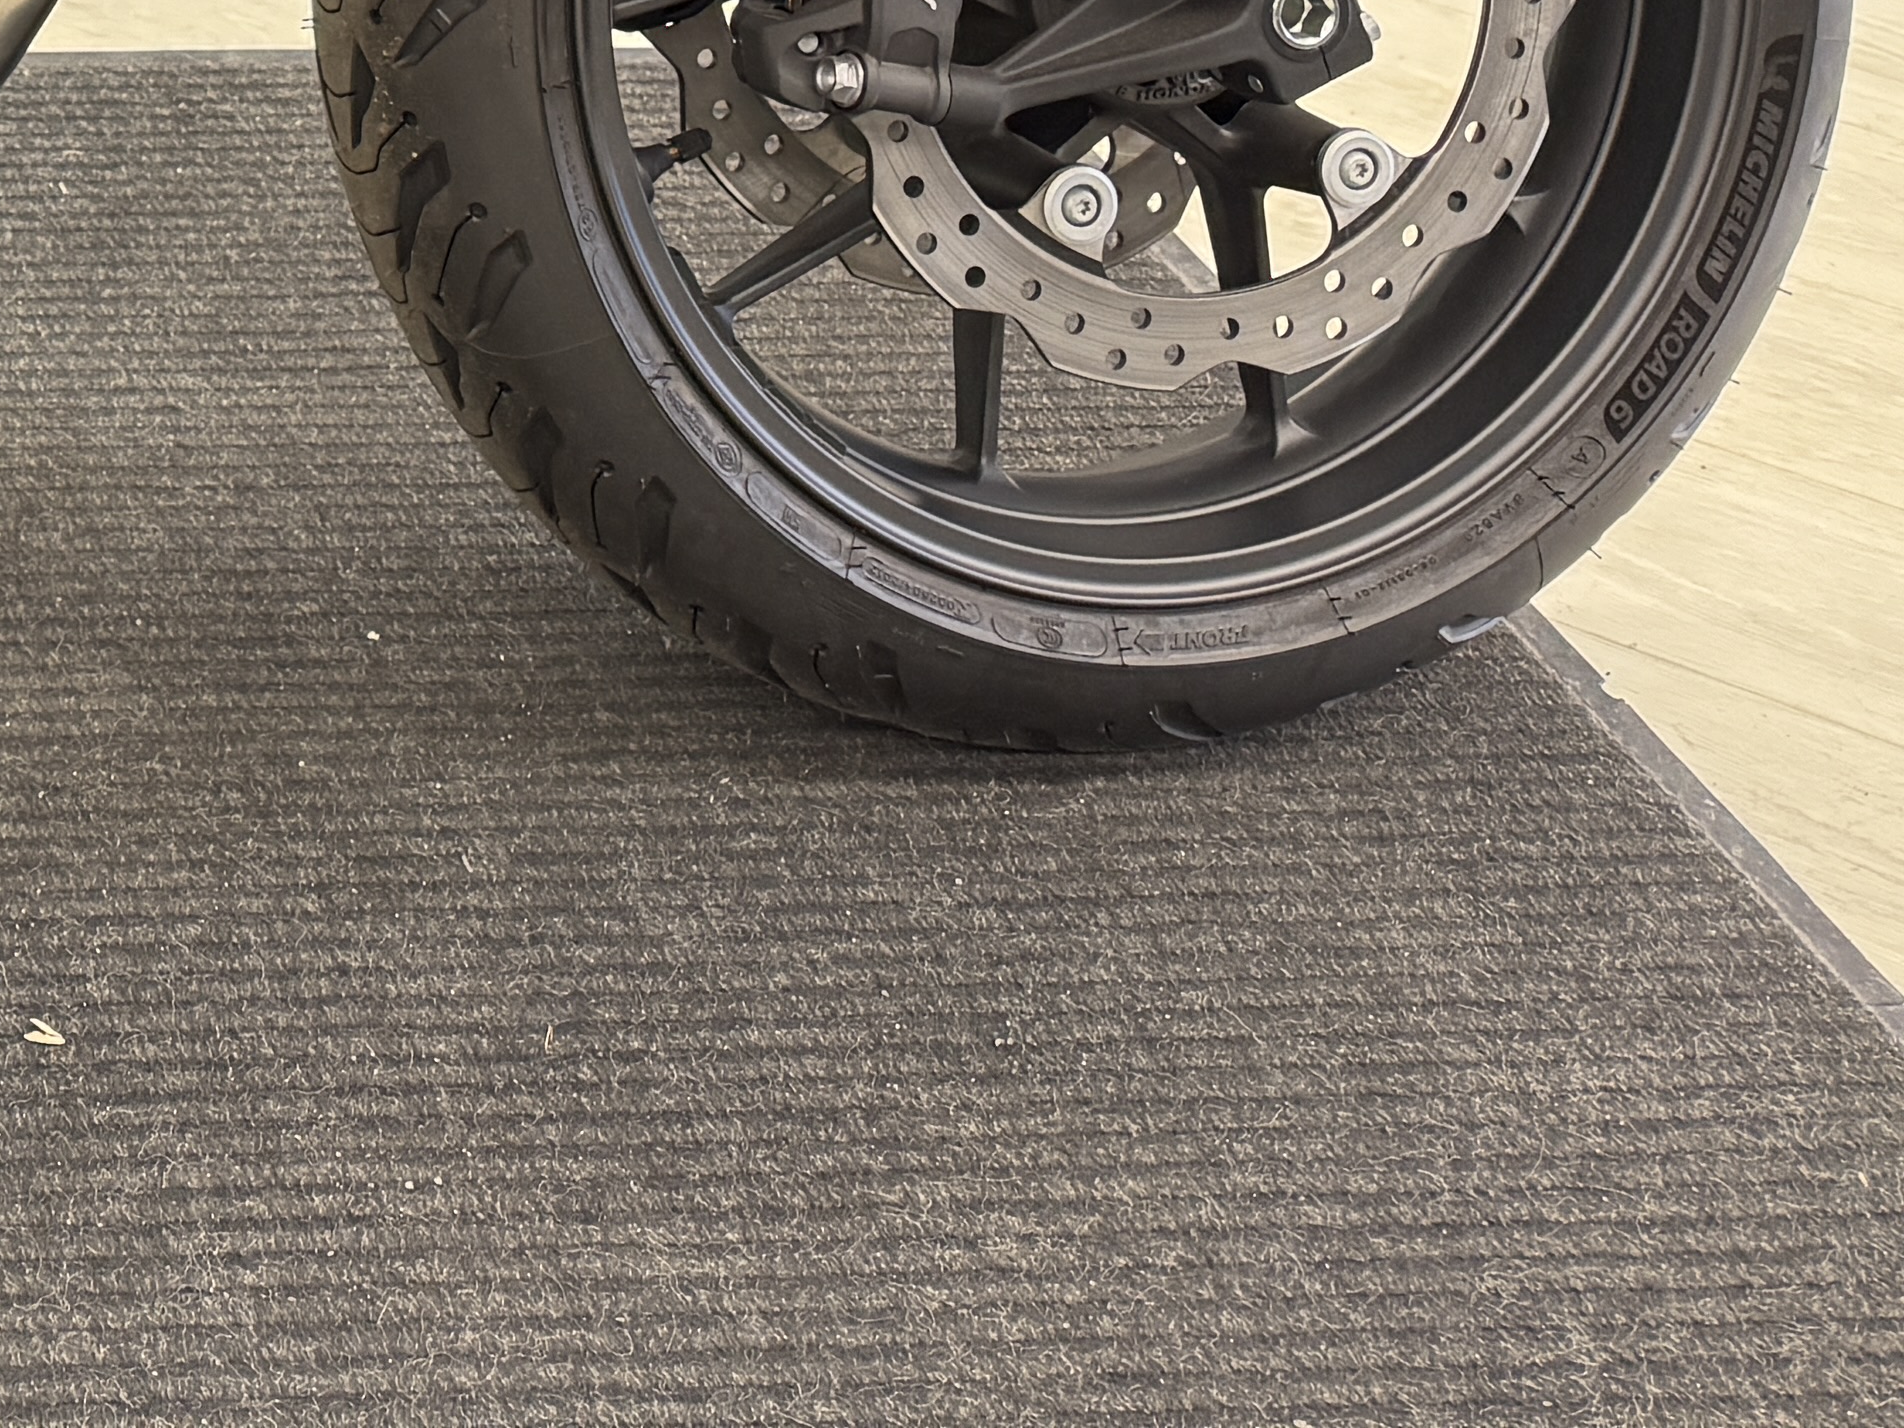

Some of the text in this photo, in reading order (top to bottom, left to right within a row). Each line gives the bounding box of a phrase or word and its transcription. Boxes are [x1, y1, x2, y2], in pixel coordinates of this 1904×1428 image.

[1609, 99, 1783, 431] MICHELIN ROAD 6
[1169, 624, 1249, 651] FRONT
